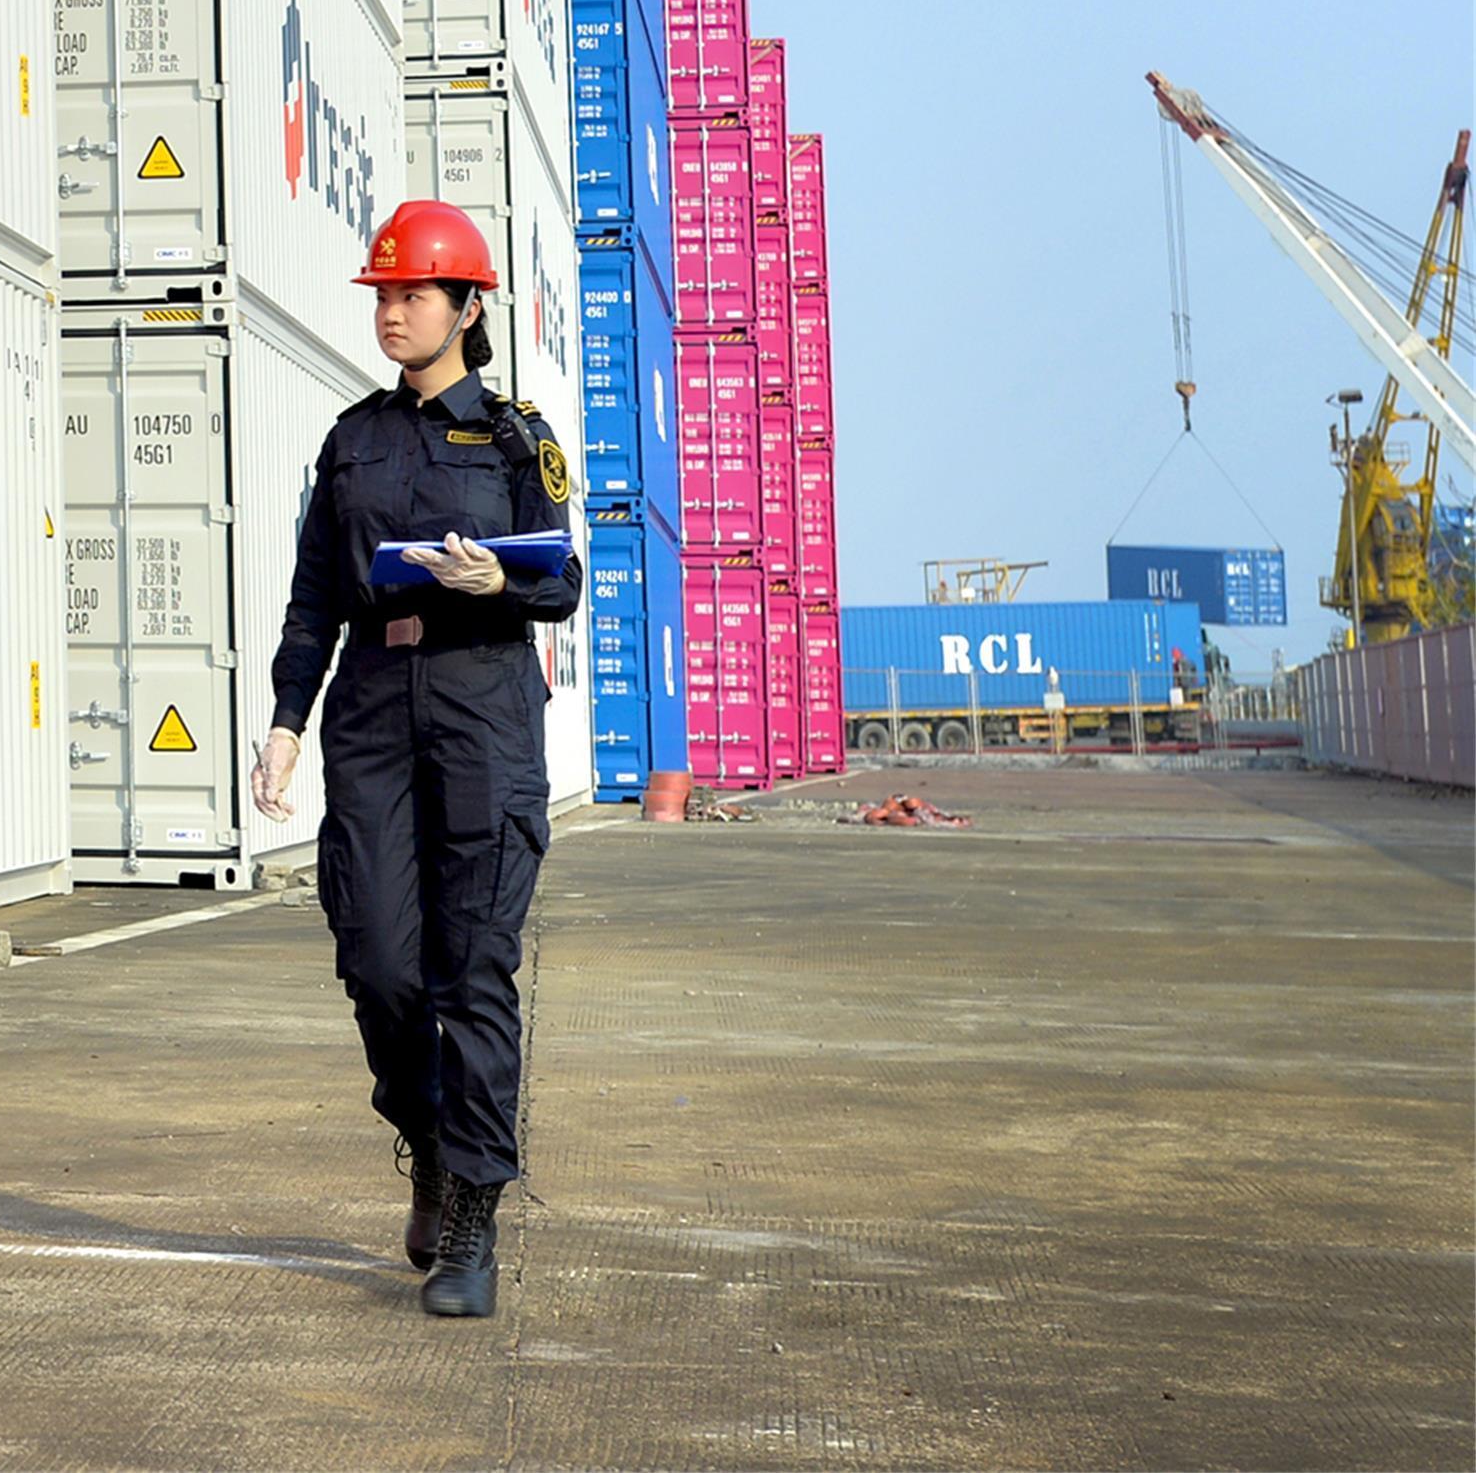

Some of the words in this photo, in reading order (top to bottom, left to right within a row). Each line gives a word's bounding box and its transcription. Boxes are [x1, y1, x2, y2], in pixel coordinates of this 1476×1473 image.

[495, 148, 503, 161] 2
[443, 168, 471, 182] 45G1
[133, 414, 192, 436] 104750
[211, 413, 221, 434] 0
[133, 444, 173, 465] 45G1
[76, 539, 115, 561] GROSS
[1147, 569, 1182, 598] RCL
[940, 633, 1042, 674] RCL
